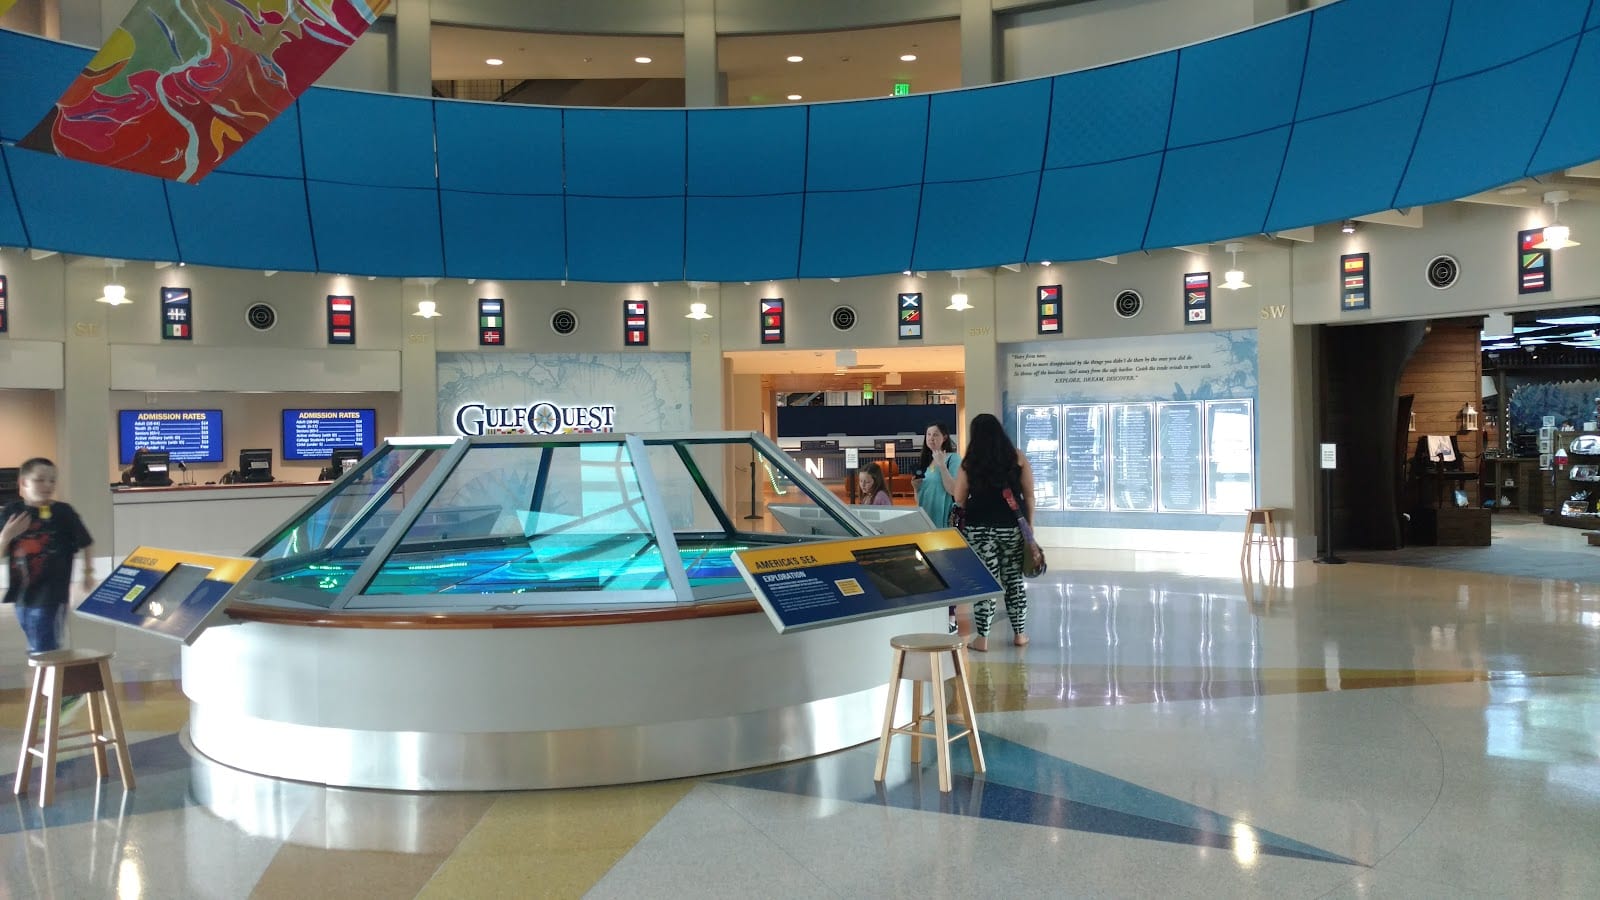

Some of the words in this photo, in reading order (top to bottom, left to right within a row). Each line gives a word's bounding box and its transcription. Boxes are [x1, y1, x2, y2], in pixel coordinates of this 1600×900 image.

[1260, 304, 1286, 320] SW
[754, 556, 800, 570] AMERICA'S
[800, 555, 818, 564] SEA
[762, 570, 807, 583] EXPLORATION
